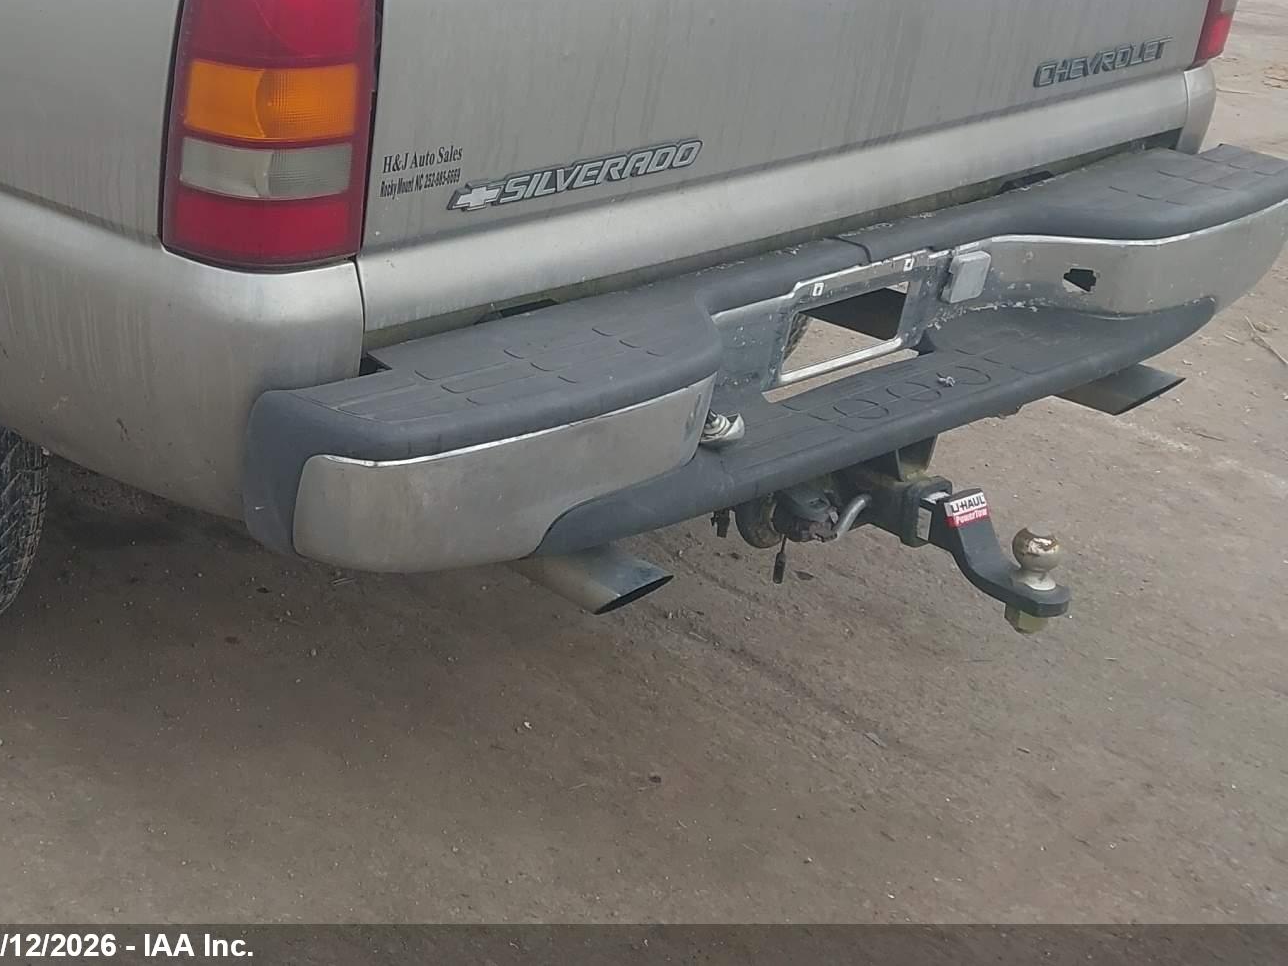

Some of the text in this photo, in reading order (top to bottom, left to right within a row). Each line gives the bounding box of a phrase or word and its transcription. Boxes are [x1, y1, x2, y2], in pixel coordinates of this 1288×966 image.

[1033, 35, 1173, 88] CHEVROLET
[383, 145, 463, 173] H&J Auto Sales
[498, 139, 703, 205] SILVERADO
[415, 173, 424, 192] NC
[952, 495, 985, 513] U-HAUL
